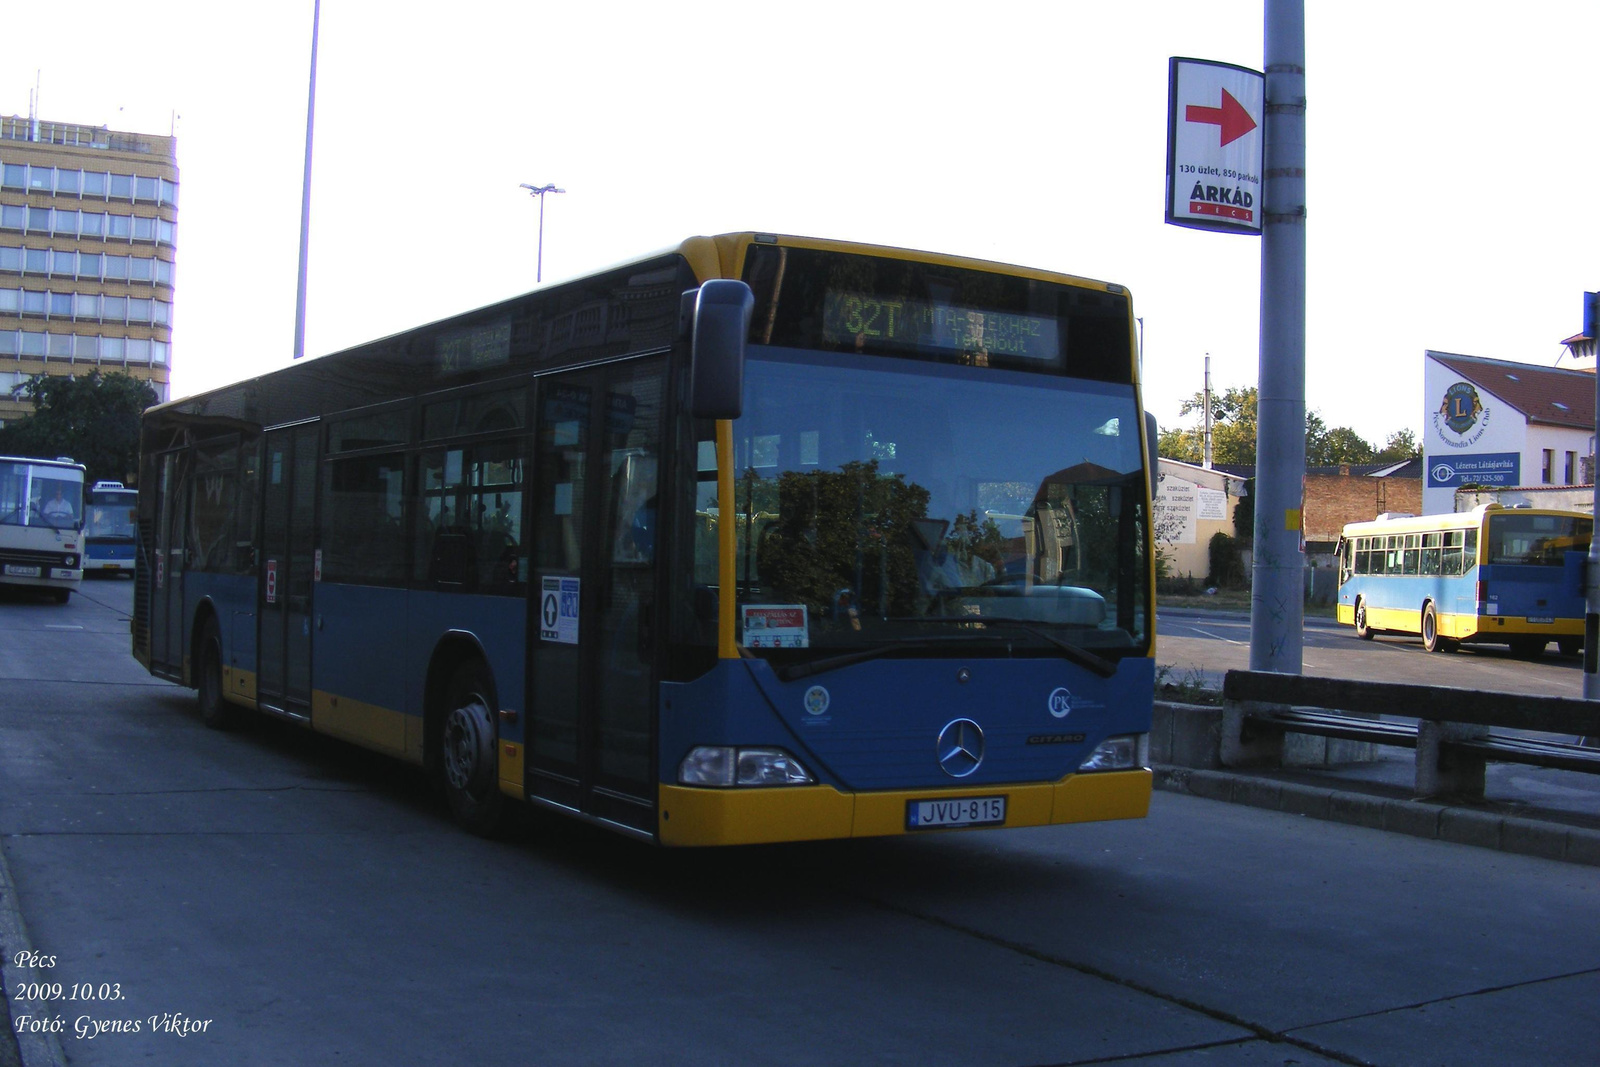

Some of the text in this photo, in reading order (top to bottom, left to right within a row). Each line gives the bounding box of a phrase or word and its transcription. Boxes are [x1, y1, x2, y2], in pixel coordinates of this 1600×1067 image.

[1179, 164, 1259, 185] 130 üzlet, 850 parkoló
[1190, 180, 1254, 208] ÁRKÁD
[1196, 205, 1250, 219] PÉCS
[1449, 384, 1473, 396] LIONS
[1454, 397, 1467, 418] L
[1468, 428, 1486, 446] Lions
[1481, 407, 1491, 427] Club
[1455, 460, 1514, 470] Lézeres Látásjavítás
[1029, 733, 1084, 744] CITARO
[922, 799, 1001, 823] JVU-815
